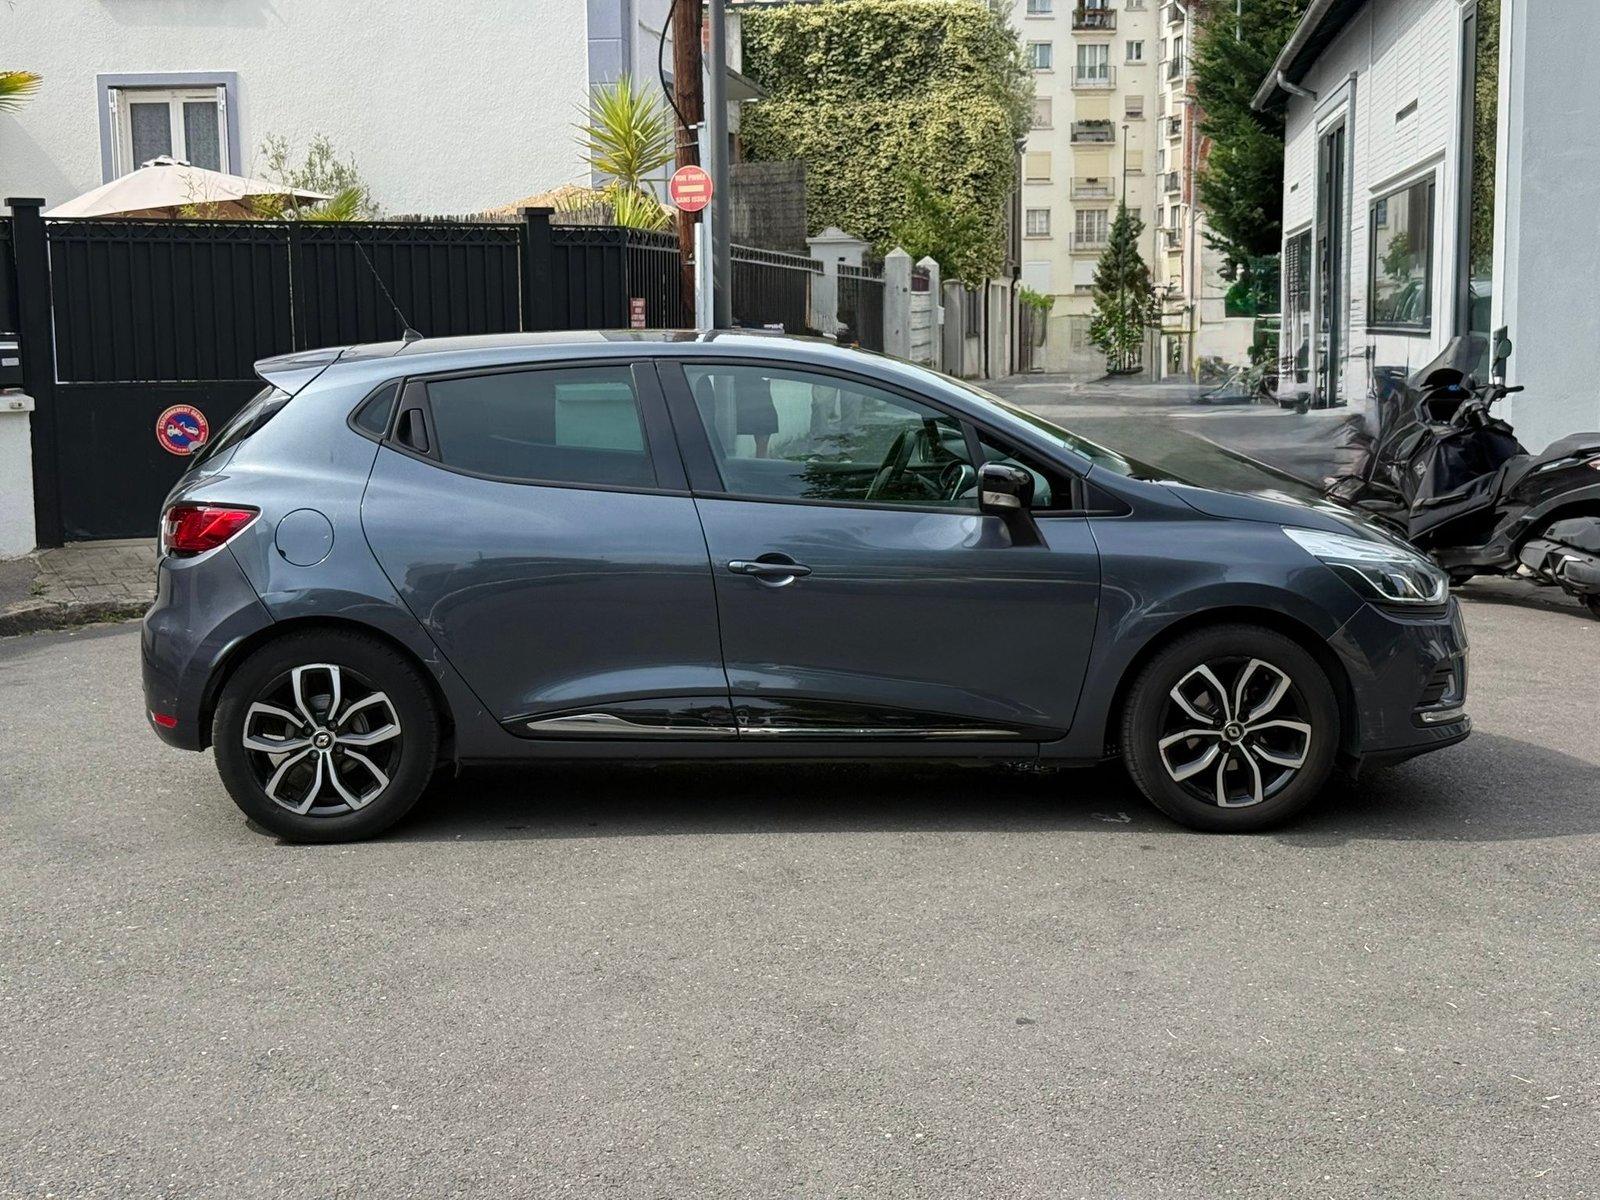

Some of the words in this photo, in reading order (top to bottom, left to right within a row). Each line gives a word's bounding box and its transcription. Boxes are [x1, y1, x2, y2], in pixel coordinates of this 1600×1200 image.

[674, 174, 687, 182] VOIE
[691, 195, 707, 203] ISSUE
[159, 407, 191, 429] STATIONNEMENT
